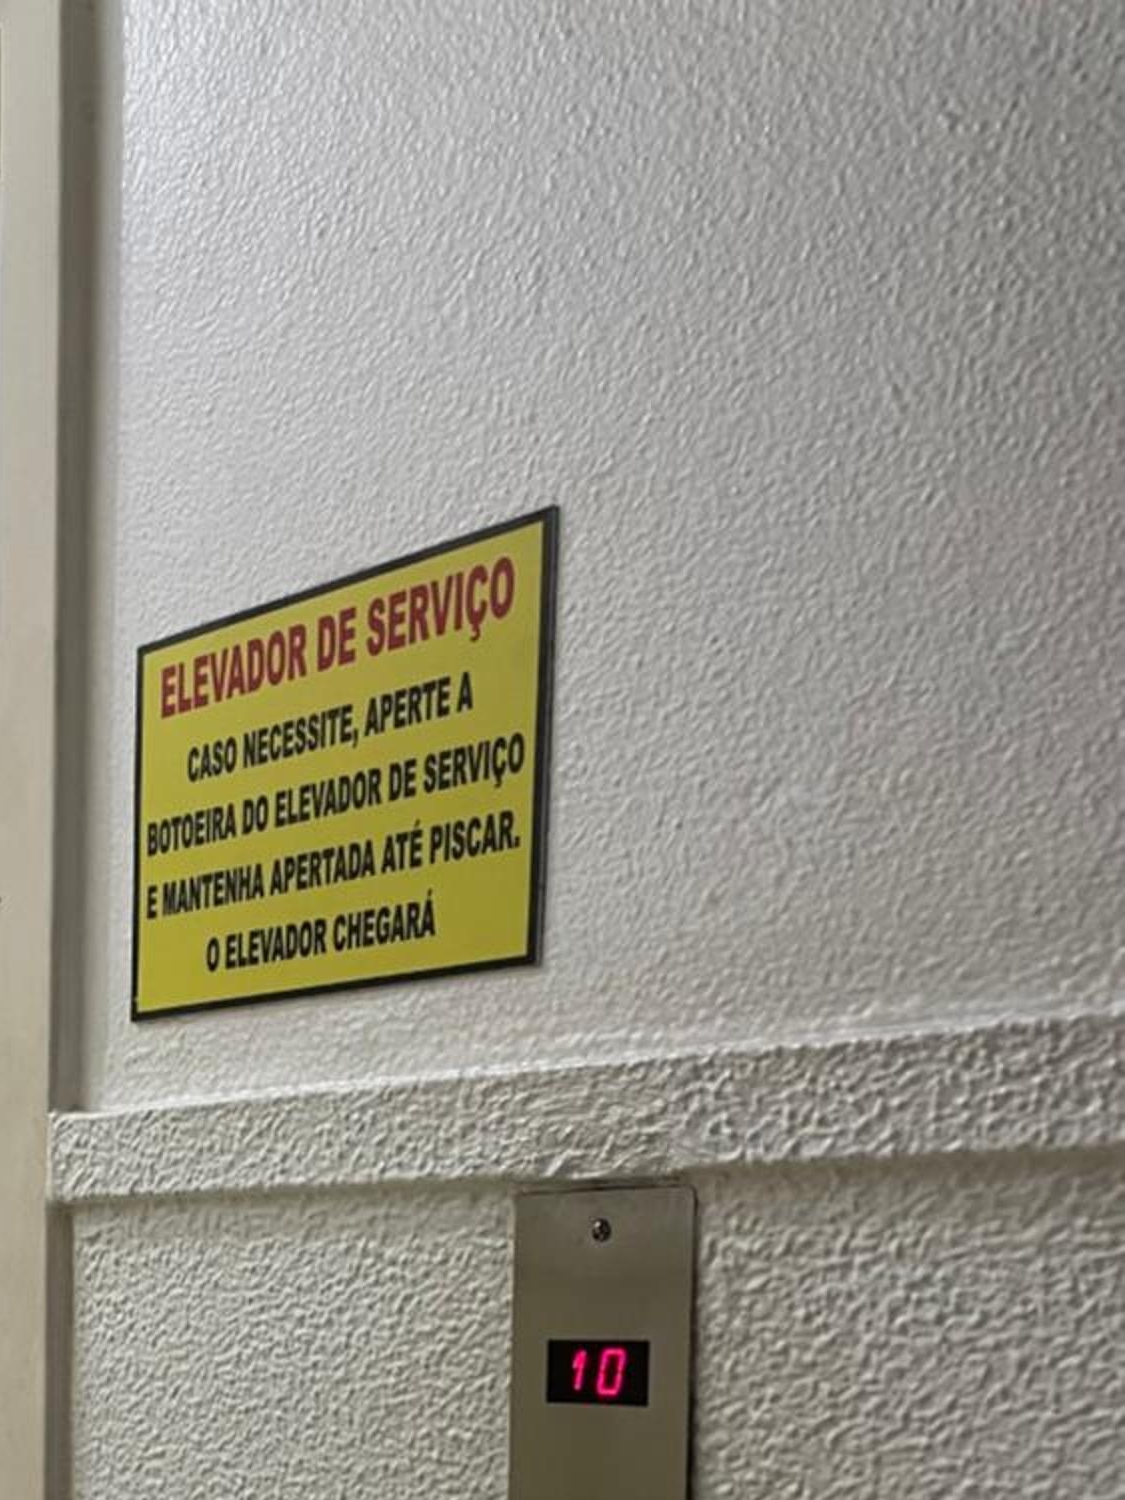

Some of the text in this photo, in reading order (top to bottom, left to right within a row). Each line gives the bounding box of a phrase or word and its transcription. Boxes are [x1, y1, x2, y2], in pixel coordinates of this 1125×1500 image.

[161, 557, 515, 718] ELEVADOR DE SERVIÇO
[187, 671, 473, 783] CASO NECESSITE, APERTE A
[147, 732, 525, 857] BOTOEIRA DO ELEVADOR DE SERVIÇO
[146, 810, 521, 920] E MANTENHA APERTADA ATÉ PISCAR.
[206, 889, 436, 973] O ELEVADOR CHEGARÁ
[572, 1347, 626, 1396] 10
